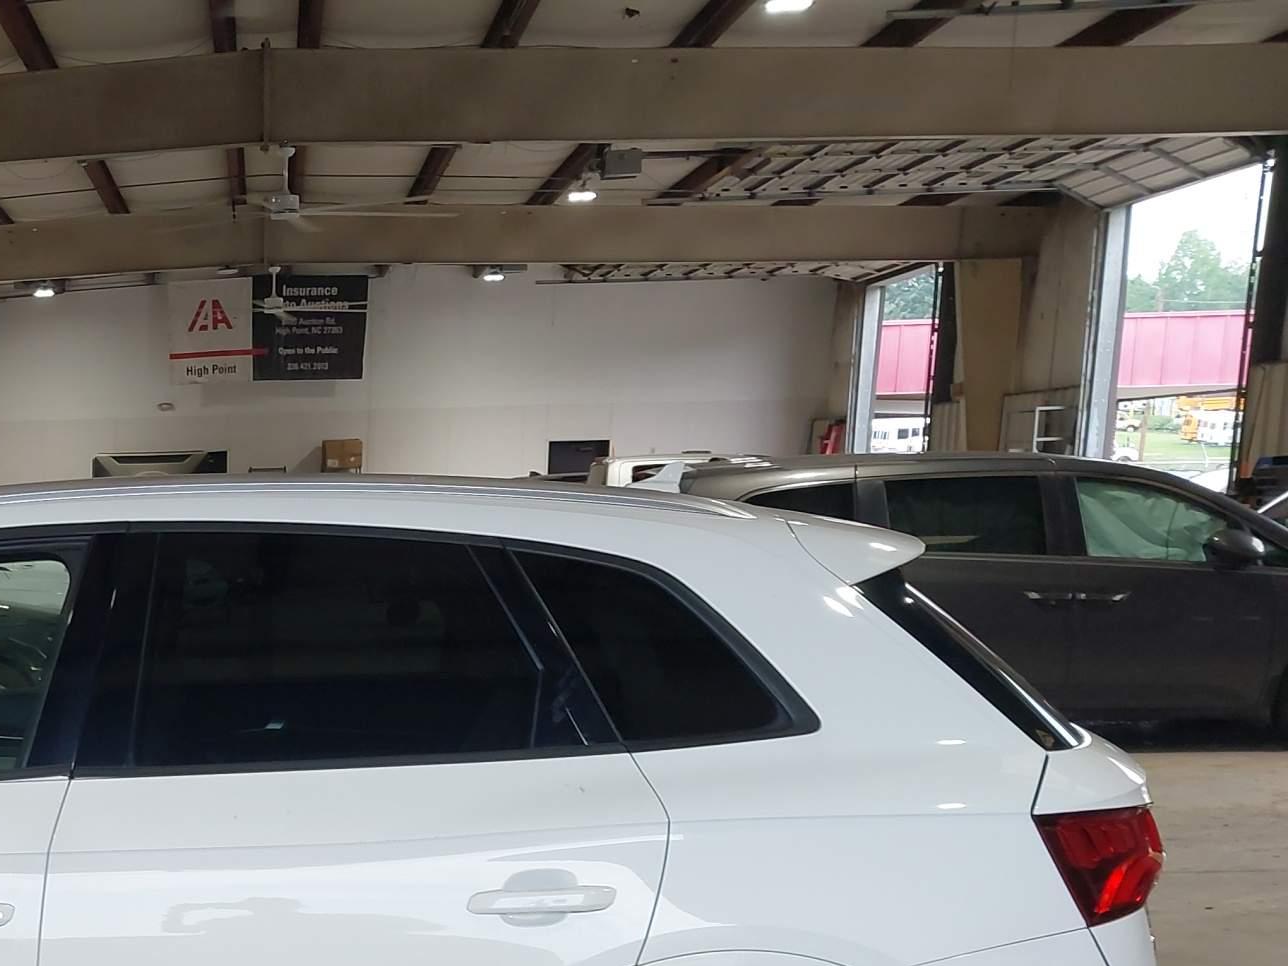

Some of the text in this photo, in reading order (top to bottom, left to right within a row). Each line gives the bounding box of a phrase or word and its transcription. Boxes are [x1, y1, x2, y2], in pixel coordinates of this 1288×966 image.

[282, 284, 338, 297] Insurance
[311, 326, 322, 335] NC
[186, 363, 237, 377] High Point
